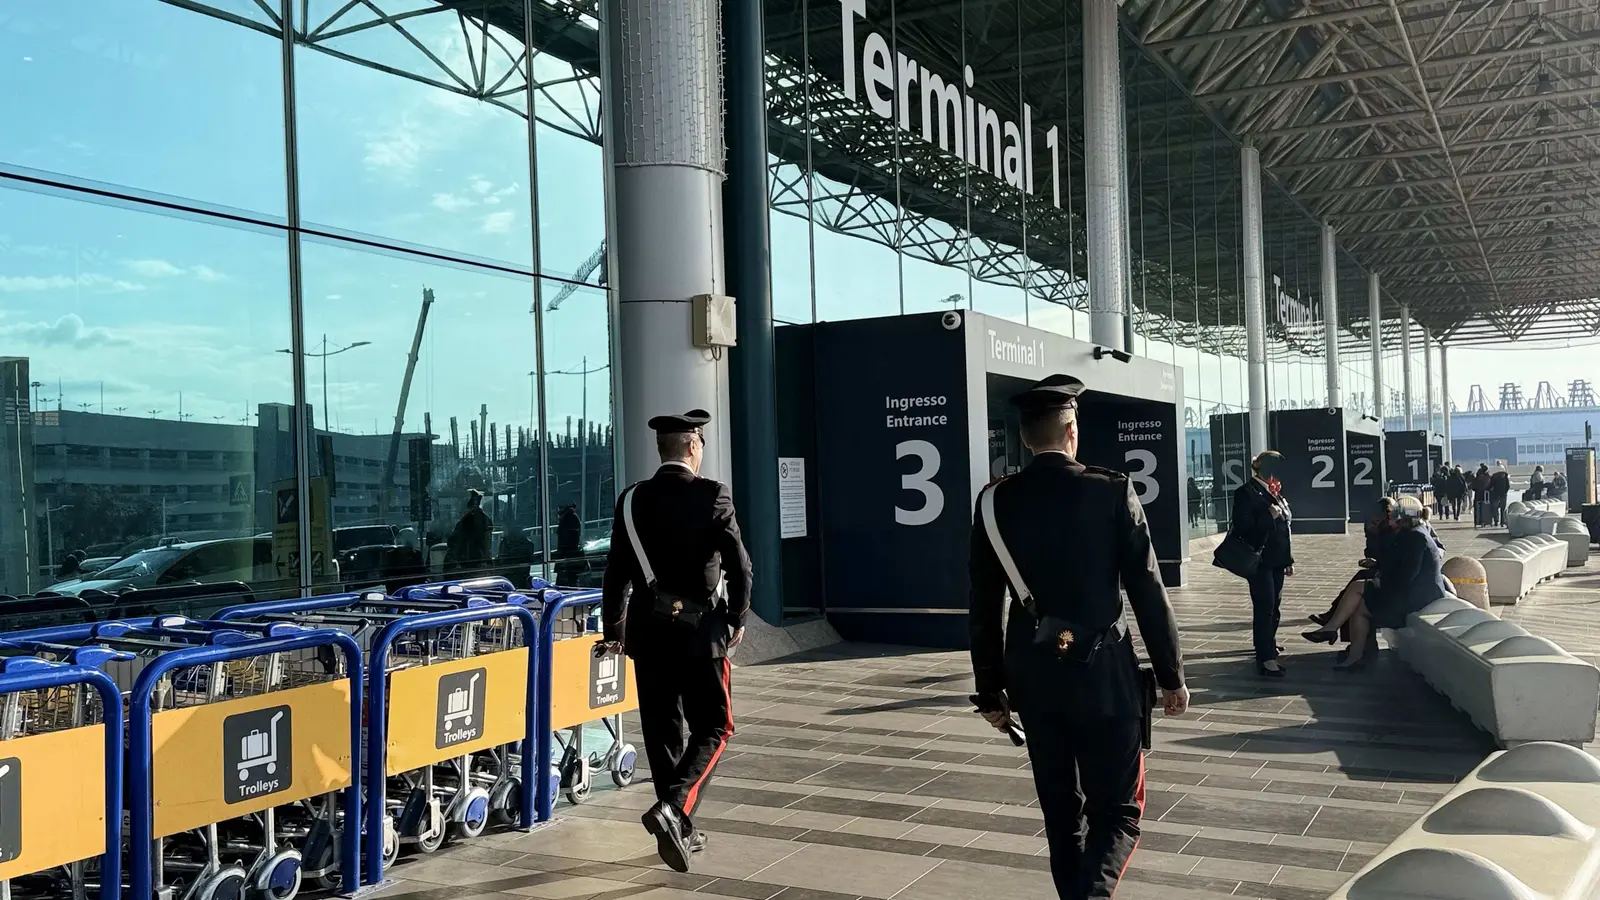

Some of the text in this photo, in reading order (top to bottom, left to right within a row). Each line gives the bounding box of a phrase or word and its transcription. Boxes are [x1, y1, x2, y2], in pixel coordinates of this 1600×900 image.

[839, 0, 1060, 208] Terminal 1
[988, 329, 1044, 368] Terminal 1
[885, 395, 947, 411] Ingresso
[886, 415, 948, 428] Entrance
[1118, 420, 1162, 431] Ingresso
[1118, 433, 1162, 442] Entrance
[1125, 449, 1160, 505] 3
[1312, 455, 1335, 488] 2
[1354, 457, 1373, 485] 2
[1408, 459, 1419, 480] 1
[895, 440, 945, 526] 3
[597, 693, 618, 705] Trolleys
[443, 728, 476, 744] Trolleys
[239, 779, 279, 797] Trolleys
